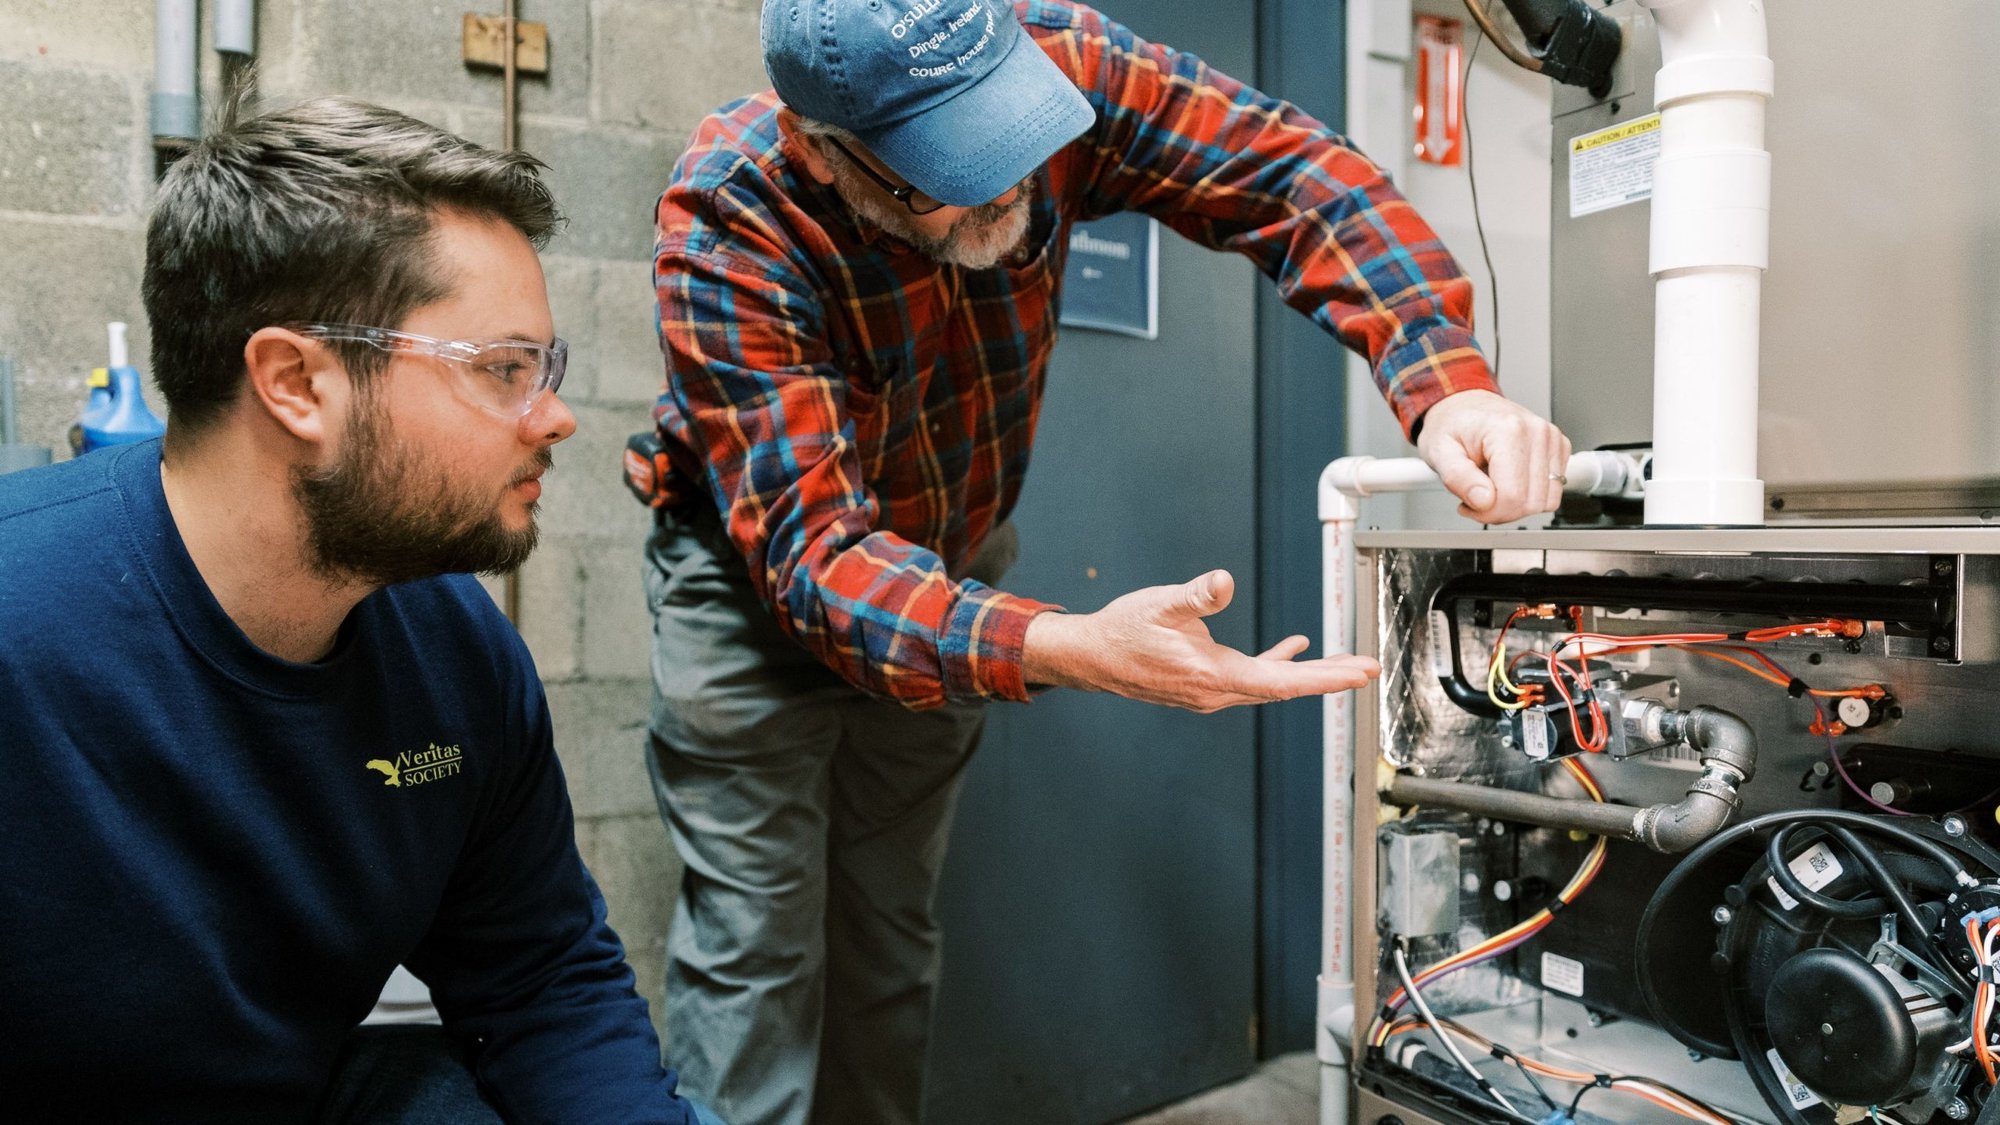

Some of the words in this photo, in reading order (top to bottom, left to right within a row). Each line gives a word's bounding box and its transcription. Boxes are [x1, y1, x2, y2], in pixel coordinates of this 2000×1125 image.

[891, 0, 941, 38] O'SULL
[908, 31, 951, 59] Dingle,
[957, 34, 989, 66] house
[1586, 131, 1620, 147] CAUTION
[1627, 119, 1660, 135] ATTENTI
[400, 742, 461, 767] Veritas
[405, 761, 462, 786] SOCIETY
